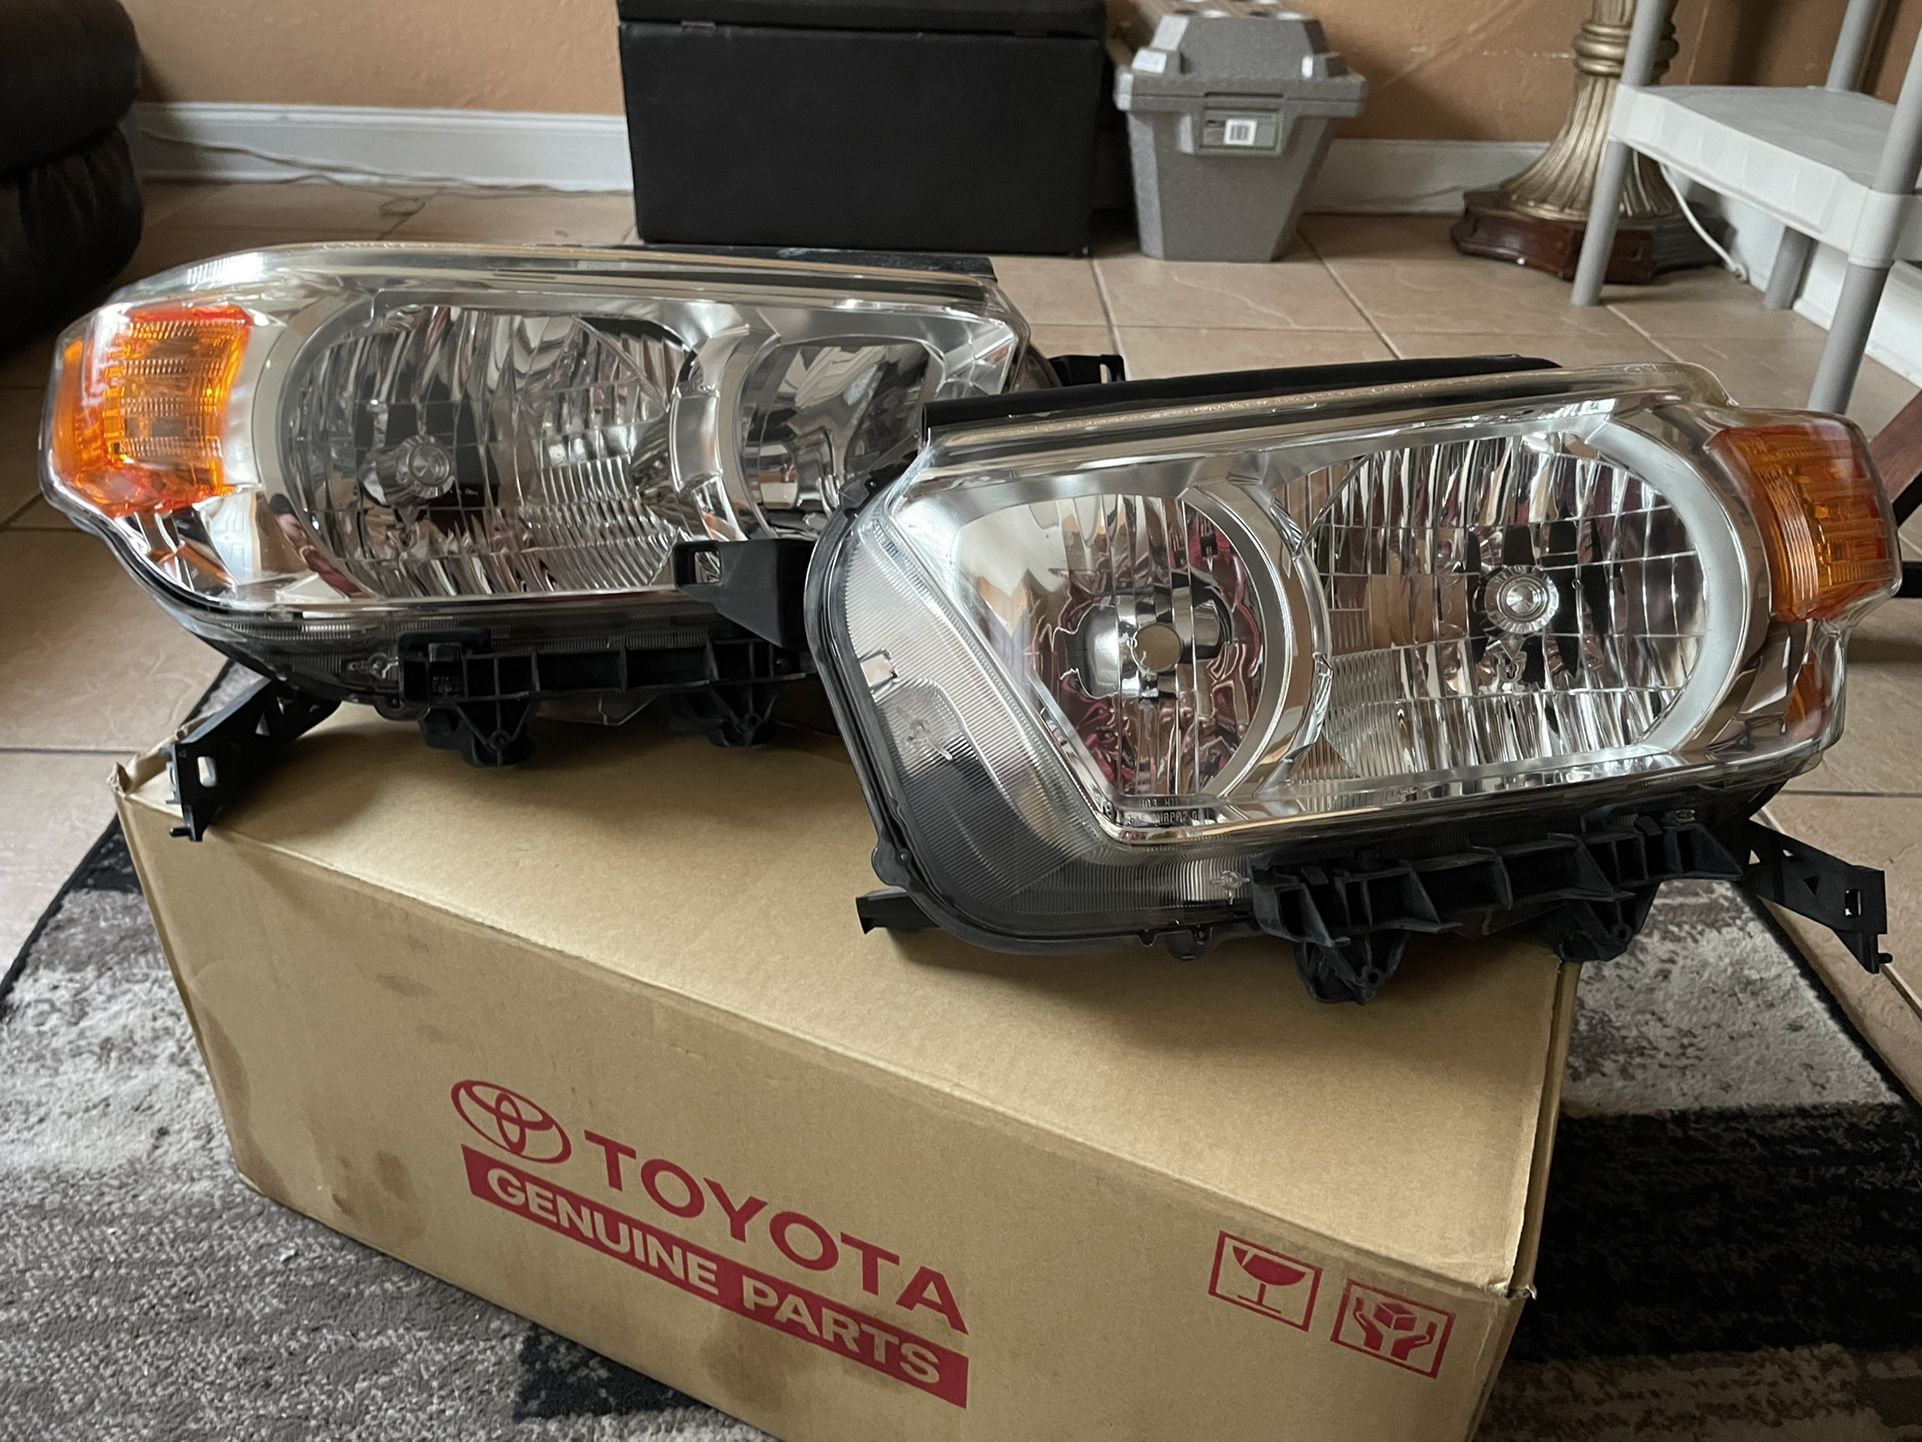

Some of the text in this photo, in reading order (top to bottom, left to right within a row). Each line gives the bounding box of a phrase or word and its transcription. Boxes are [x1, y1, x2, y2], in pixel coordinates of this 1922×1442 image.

[487, 1167, 941, 1384] GENUINE PARTS
[584, 1129, 969, 1335] TOYOTA
